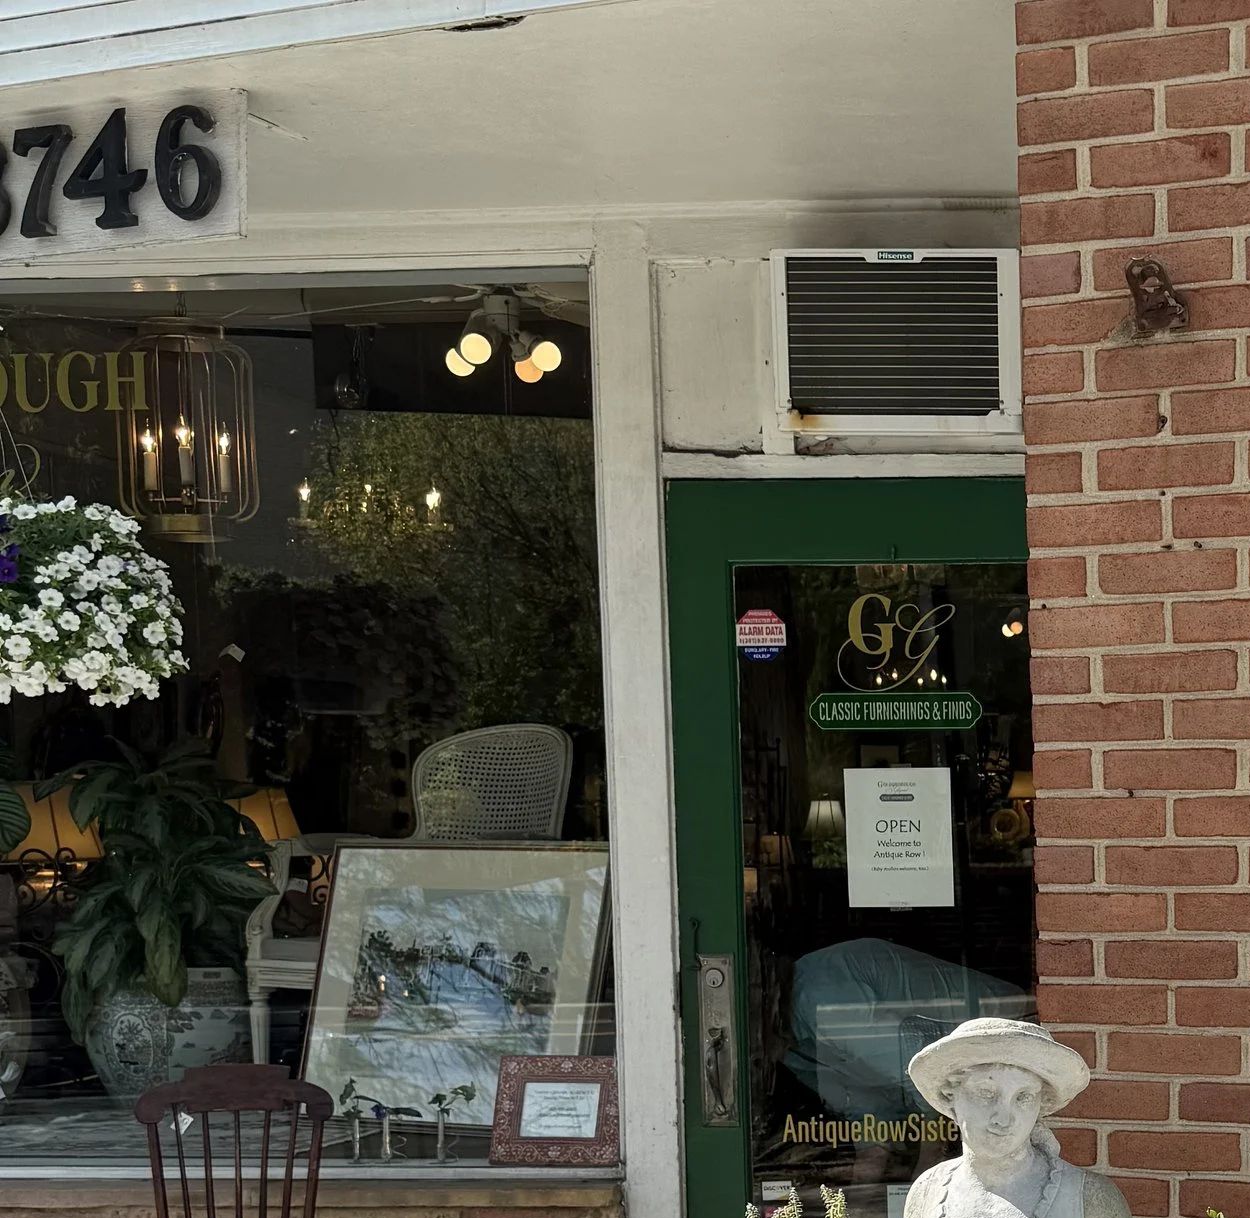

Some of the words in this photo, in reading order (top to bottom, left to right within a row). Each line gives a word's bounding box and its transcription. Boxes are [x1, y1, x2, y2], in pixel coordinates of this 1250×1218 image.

[0, 105, 222, 239] 746
[879, 252, 912, 260] Hisense
[0, 351, 150, 413] UGH
[739, 626, 764, 636] ALARM
[765, 626, 784, 636] DATA
[819, 702, 860, 721] CLASSIC
[864, 701, 930, 721] FURNISHINGS
[932, 701, 941, 720] &
[943, 701, 972, 720] FINDS
[875, 819, 921, 833] OPEN
[877, 838, 911, 847] Welcome
[873, 850, 903, 860] Antique
[783, 1113, 962, 1148] AntiqueRowSiste
